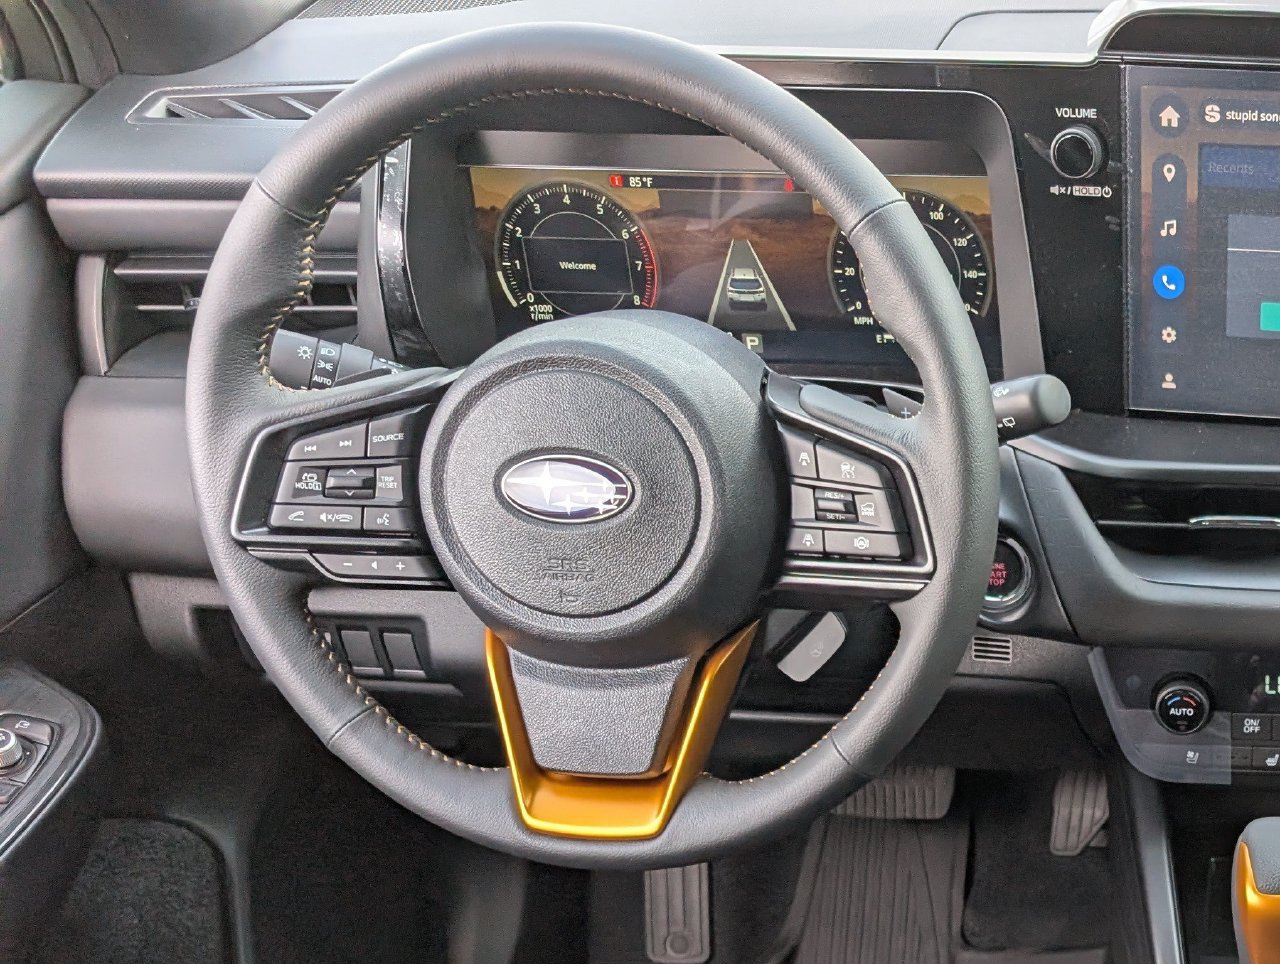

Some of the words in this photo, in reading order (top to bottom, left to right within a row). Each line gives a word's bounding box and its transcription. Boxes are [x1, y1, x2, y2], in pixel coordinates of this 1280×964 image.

[1055, 107, 1097, 118] VOLUME
[1226, 110, 1258, 123] stupid
[1208, 162, 1254, 174] Recents
[562, 194, 571, 205] 4
[533, 203, 541, 214] 3
[596, 204, 604, 215] 5
[929, 211, 944, 220] 100
[515, 227, 523, 238] 2
[621, 229, 629, 240] 6
[953, 238, 967, 247] 120
[514, 260, 521, 270] 1
[559, 261, 597, 271] Welcome
[635, 260, 642, 271] 7
[844, 267, 855, 276] 20
[963, 270, 978, 279] 140
[526, 292, 535, 303] 0
[633, 294, 641, 306] 8
[855, 301, 862, 310] 0
[854, 316, 874, 326] MPH
[746, 336, 759, 350] P
[313, 375, 332, 386] AUTO
[372, 432, 404, 443] SOURCE
[547, 558, 589, 570] SRS
[543, 572, 595, 581] AIRBAG
[1169, 707, 1194, 716] AUTO
[1244, 718, 1260, 726] ON/
[1243, 726, 1260, 734] OFF
